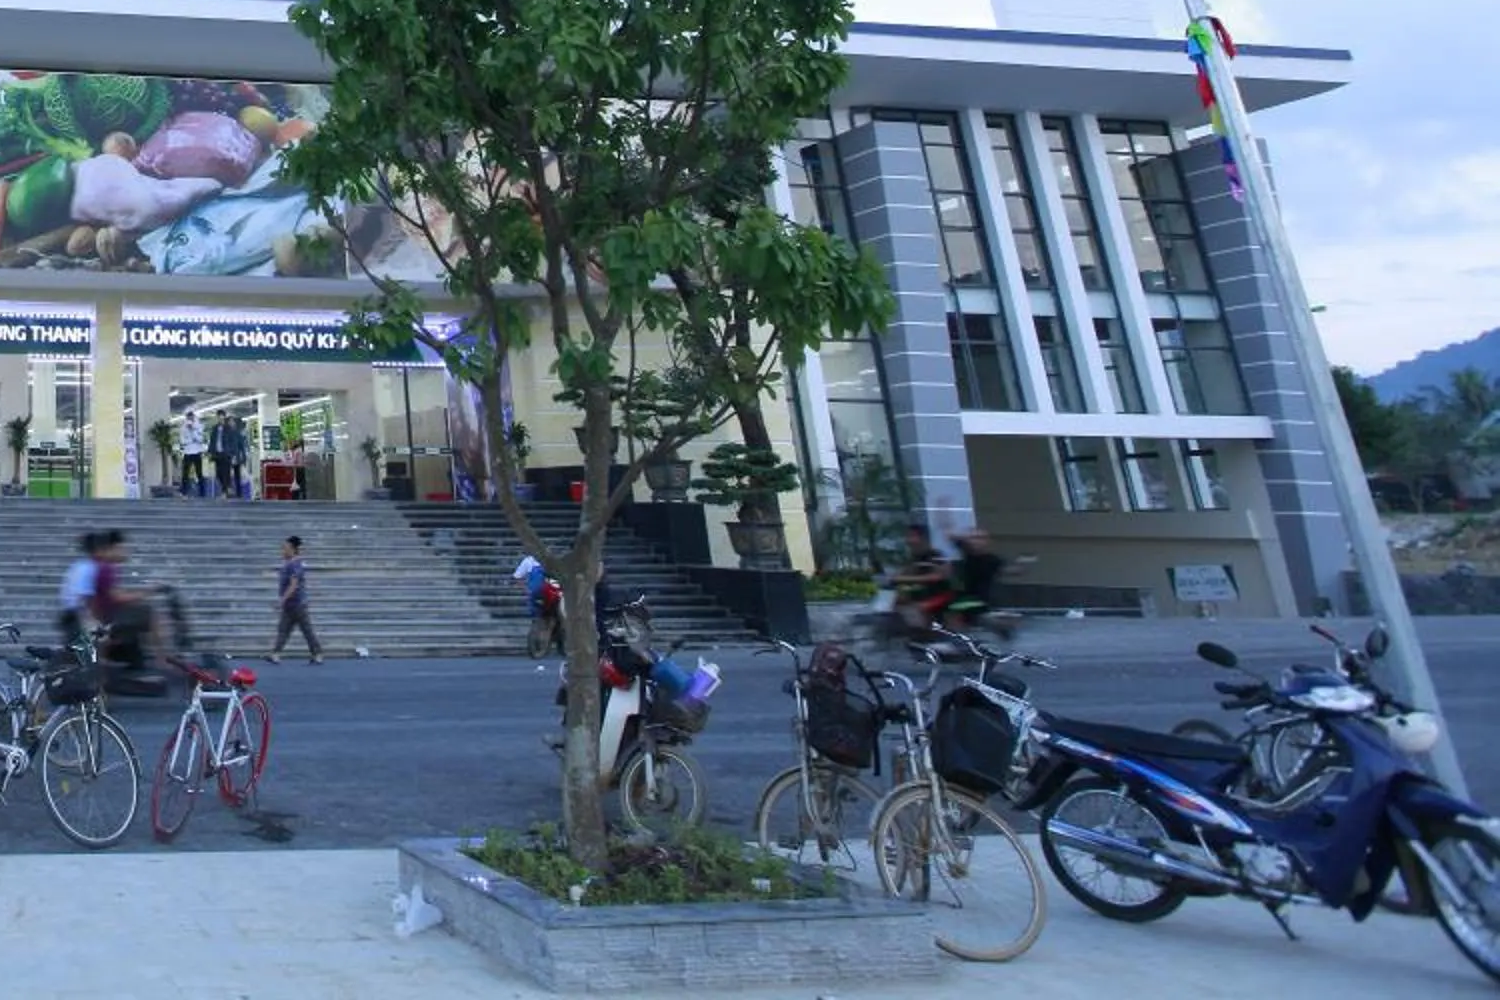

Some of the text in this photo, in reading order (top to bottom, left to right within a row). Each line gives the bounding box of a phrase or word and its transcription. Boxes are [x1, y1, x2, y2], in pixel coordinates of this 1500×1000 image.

[30, 325, 89, 343] THANH
[189, 323, 229, 347] KÍNH
[233, 326, 277, 348] CHÀO
[281, 327, 315, 350] QUÝ
